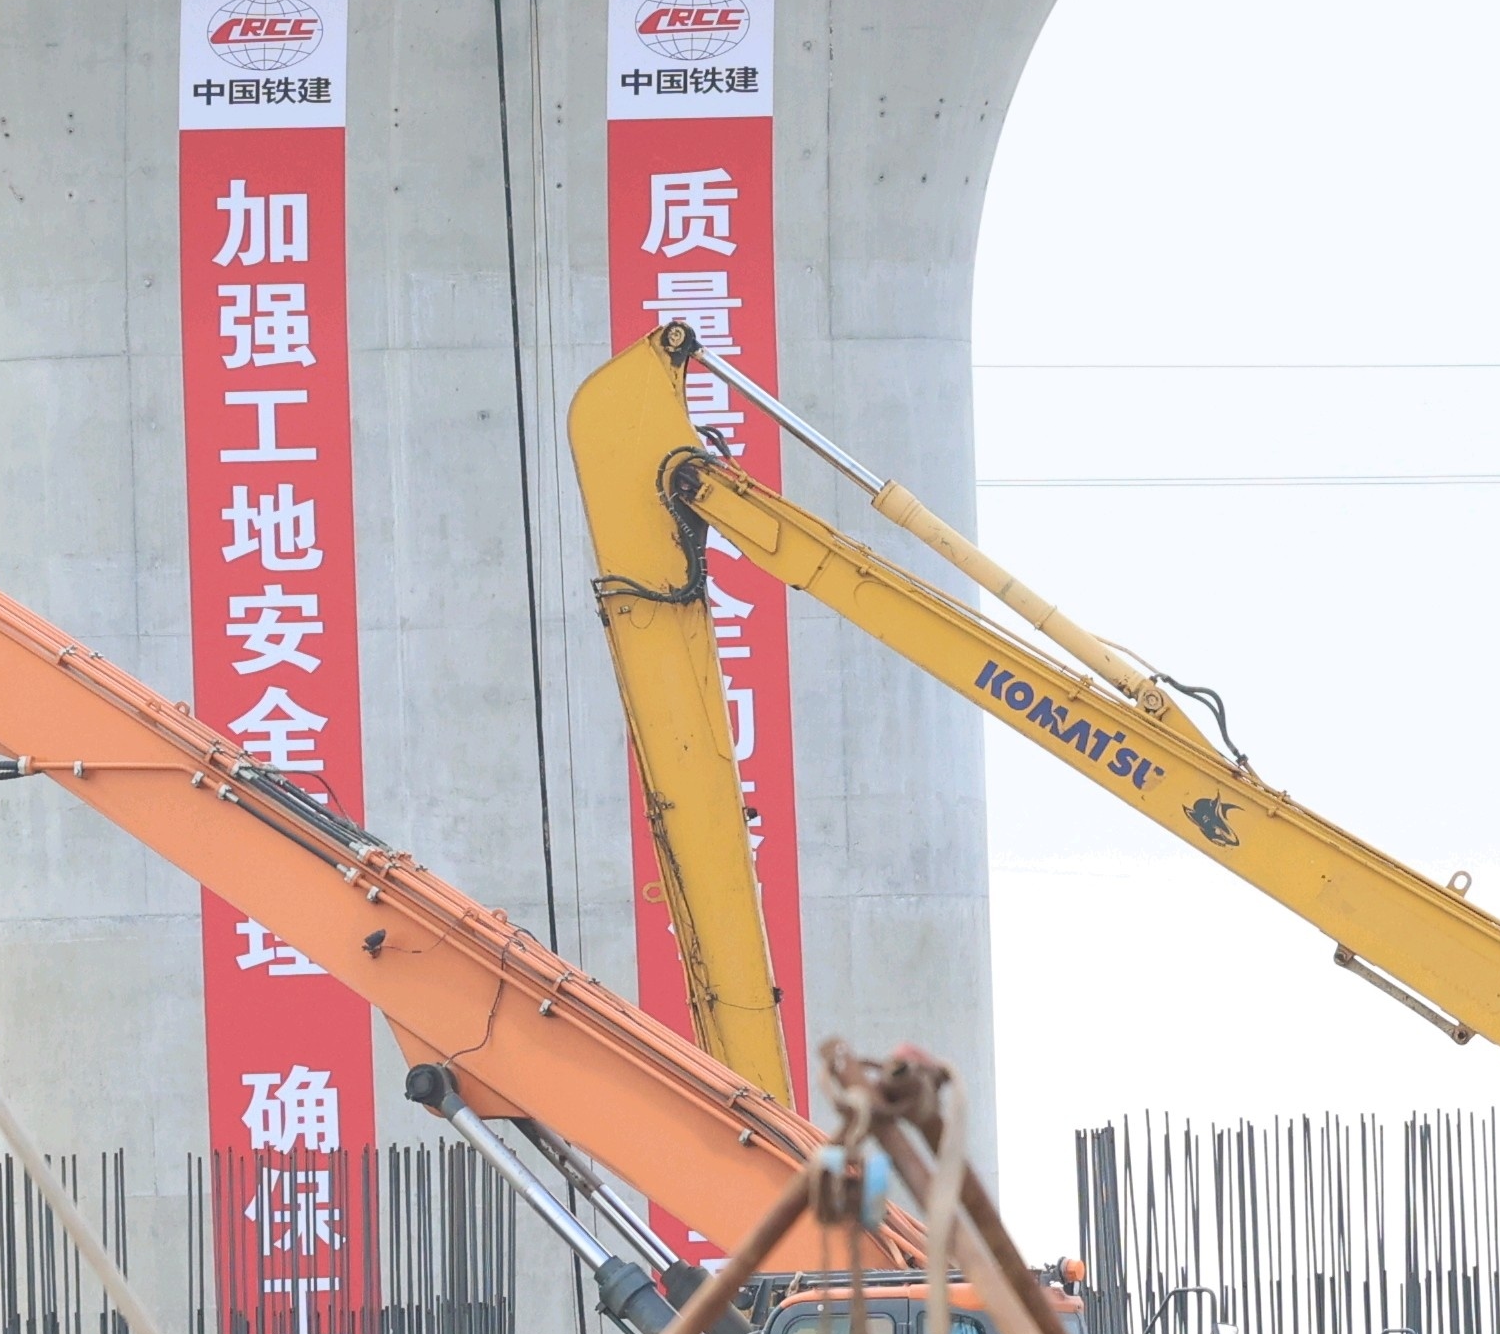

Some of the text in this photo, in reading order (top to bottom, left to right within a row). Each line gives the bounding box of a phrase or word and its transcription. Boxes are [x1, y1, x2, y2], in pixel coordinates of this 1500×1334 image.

[192, 76, 333, 106] 中国铁建
[620, 66, 760, 96] 中国铁建
[212, 179, 329, 976] 加强工地安全理
[974, 660, 1166, 791] KOMATSU
